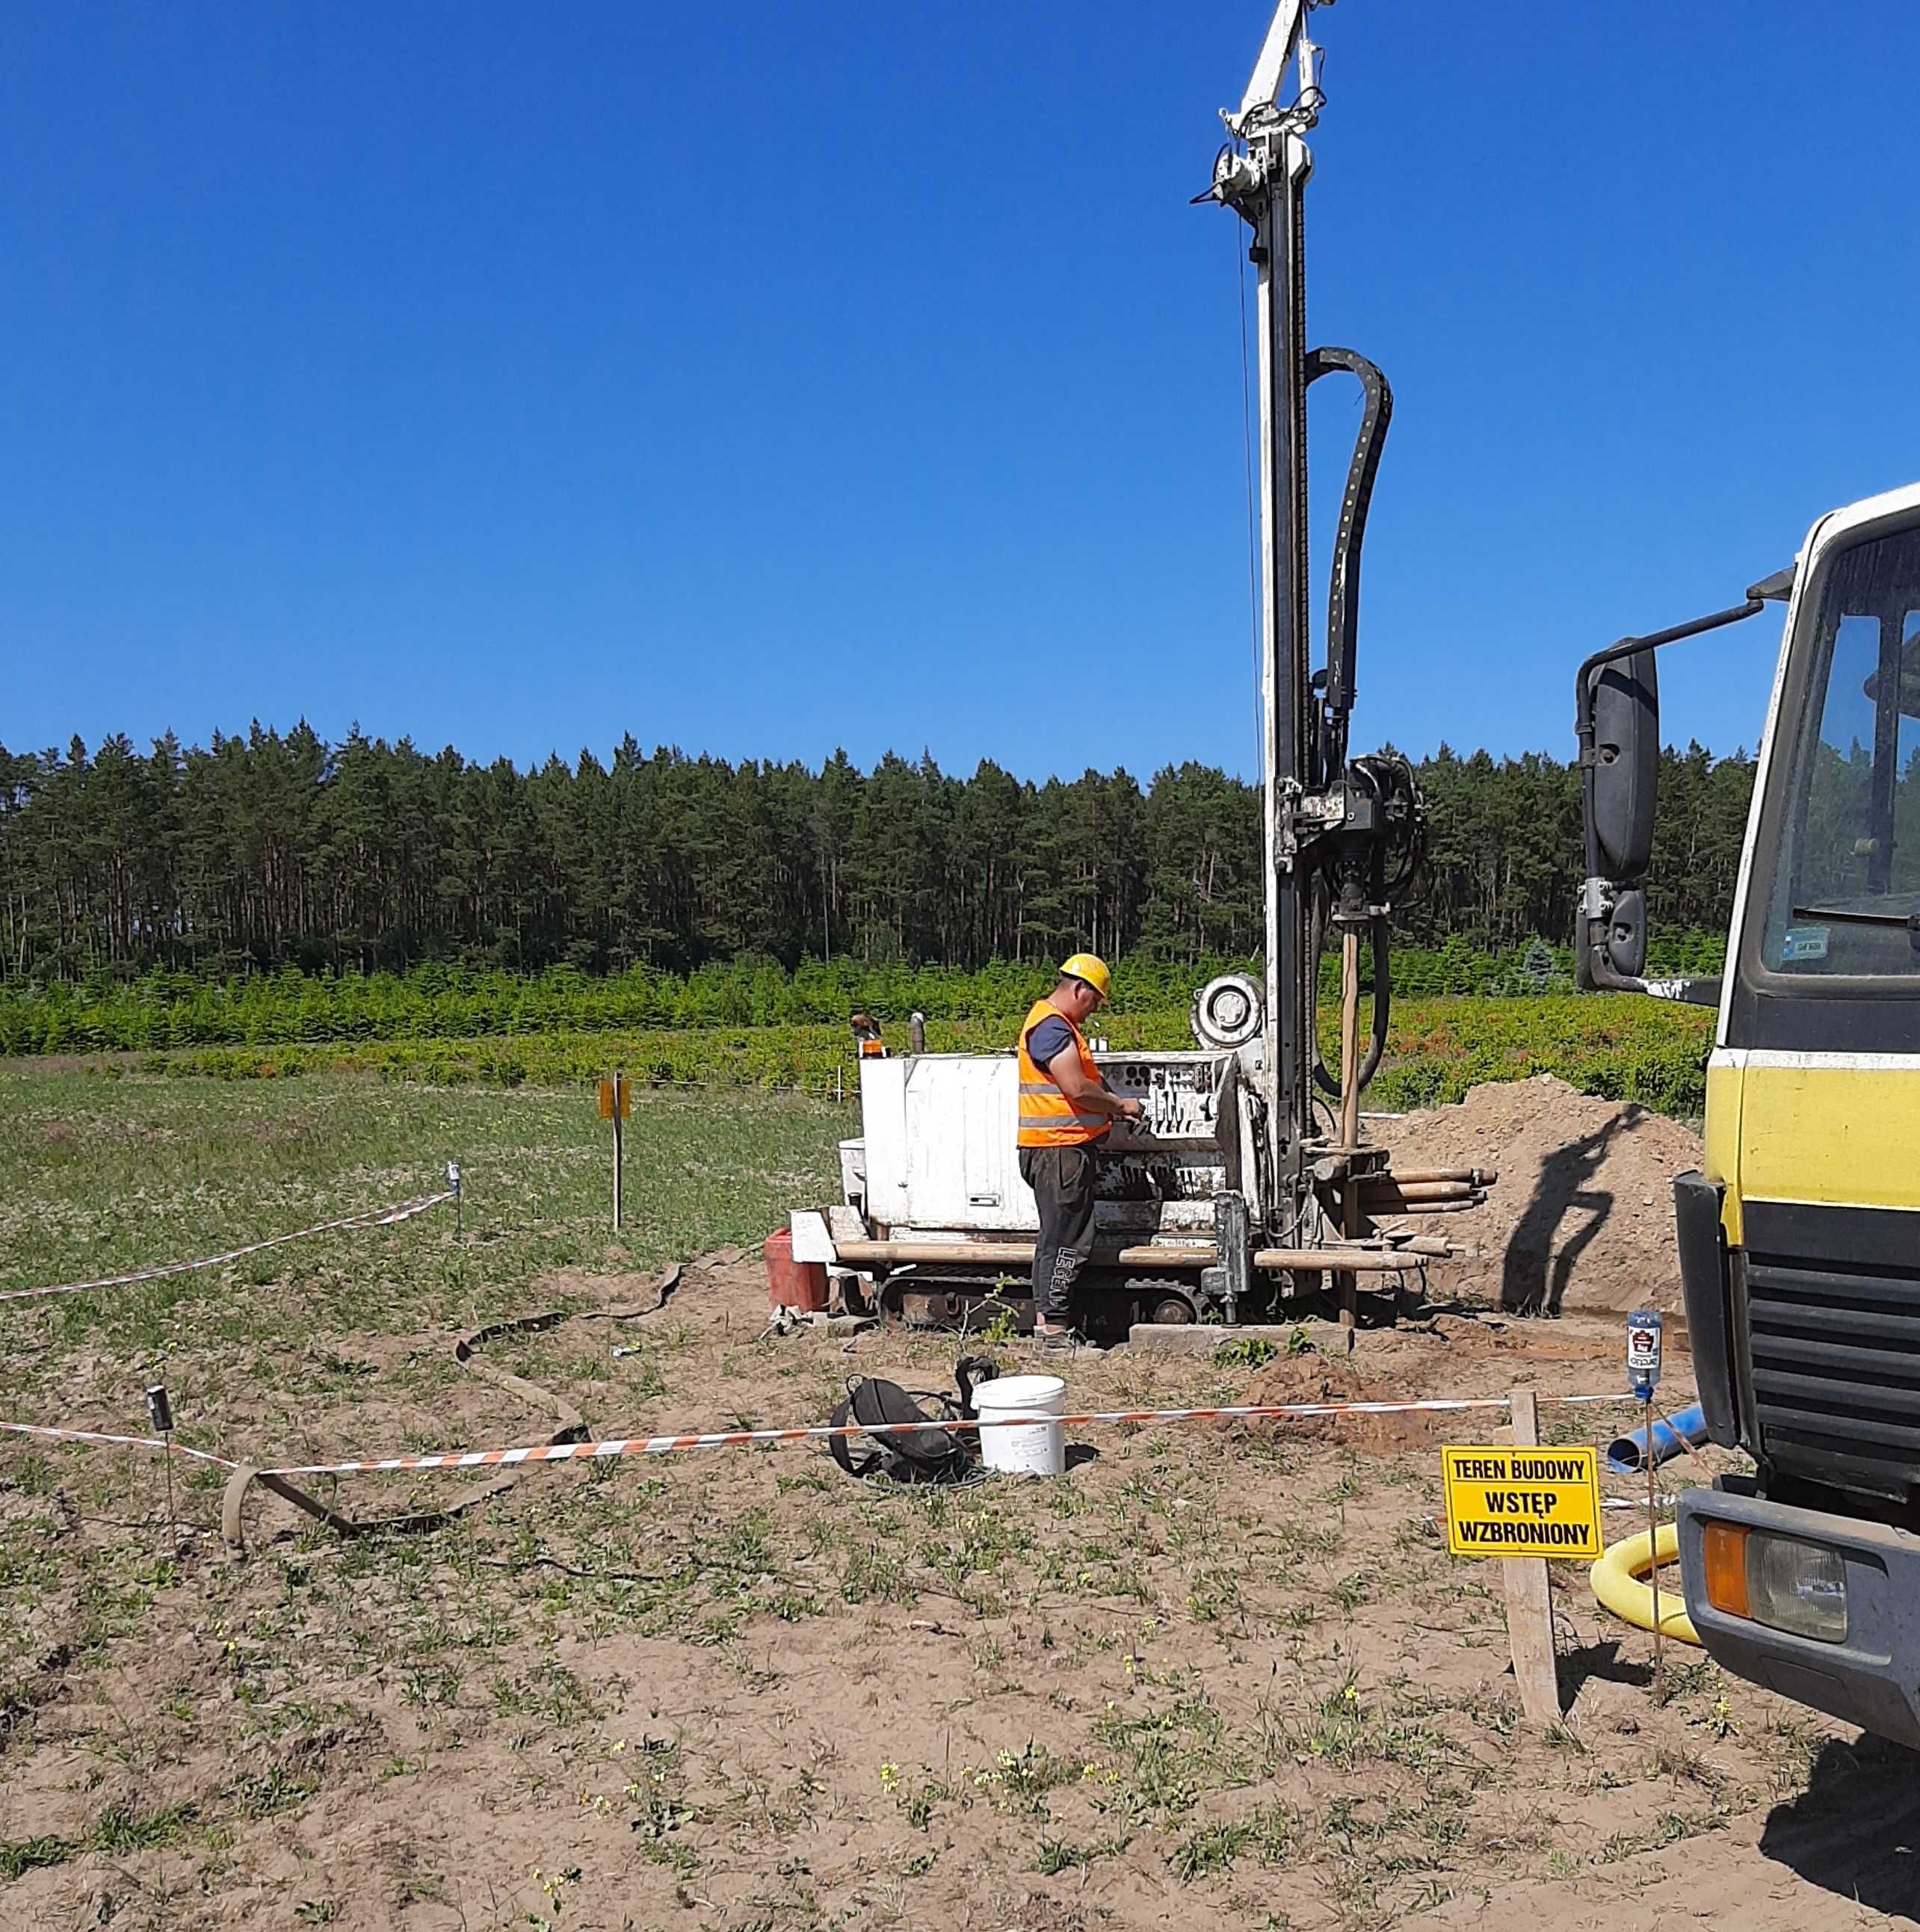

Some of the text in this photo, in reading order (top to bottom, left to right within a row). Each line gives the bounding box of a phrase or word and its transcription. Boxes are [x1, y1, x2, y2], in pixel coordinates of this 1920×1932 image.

[1453, 1459, 1585, 1480] TEREN BUDOWY
[1485, 1492, 1557, 1519] WSTĘP
[1458, 1521, 1590, 1546] WZBRONIONY
